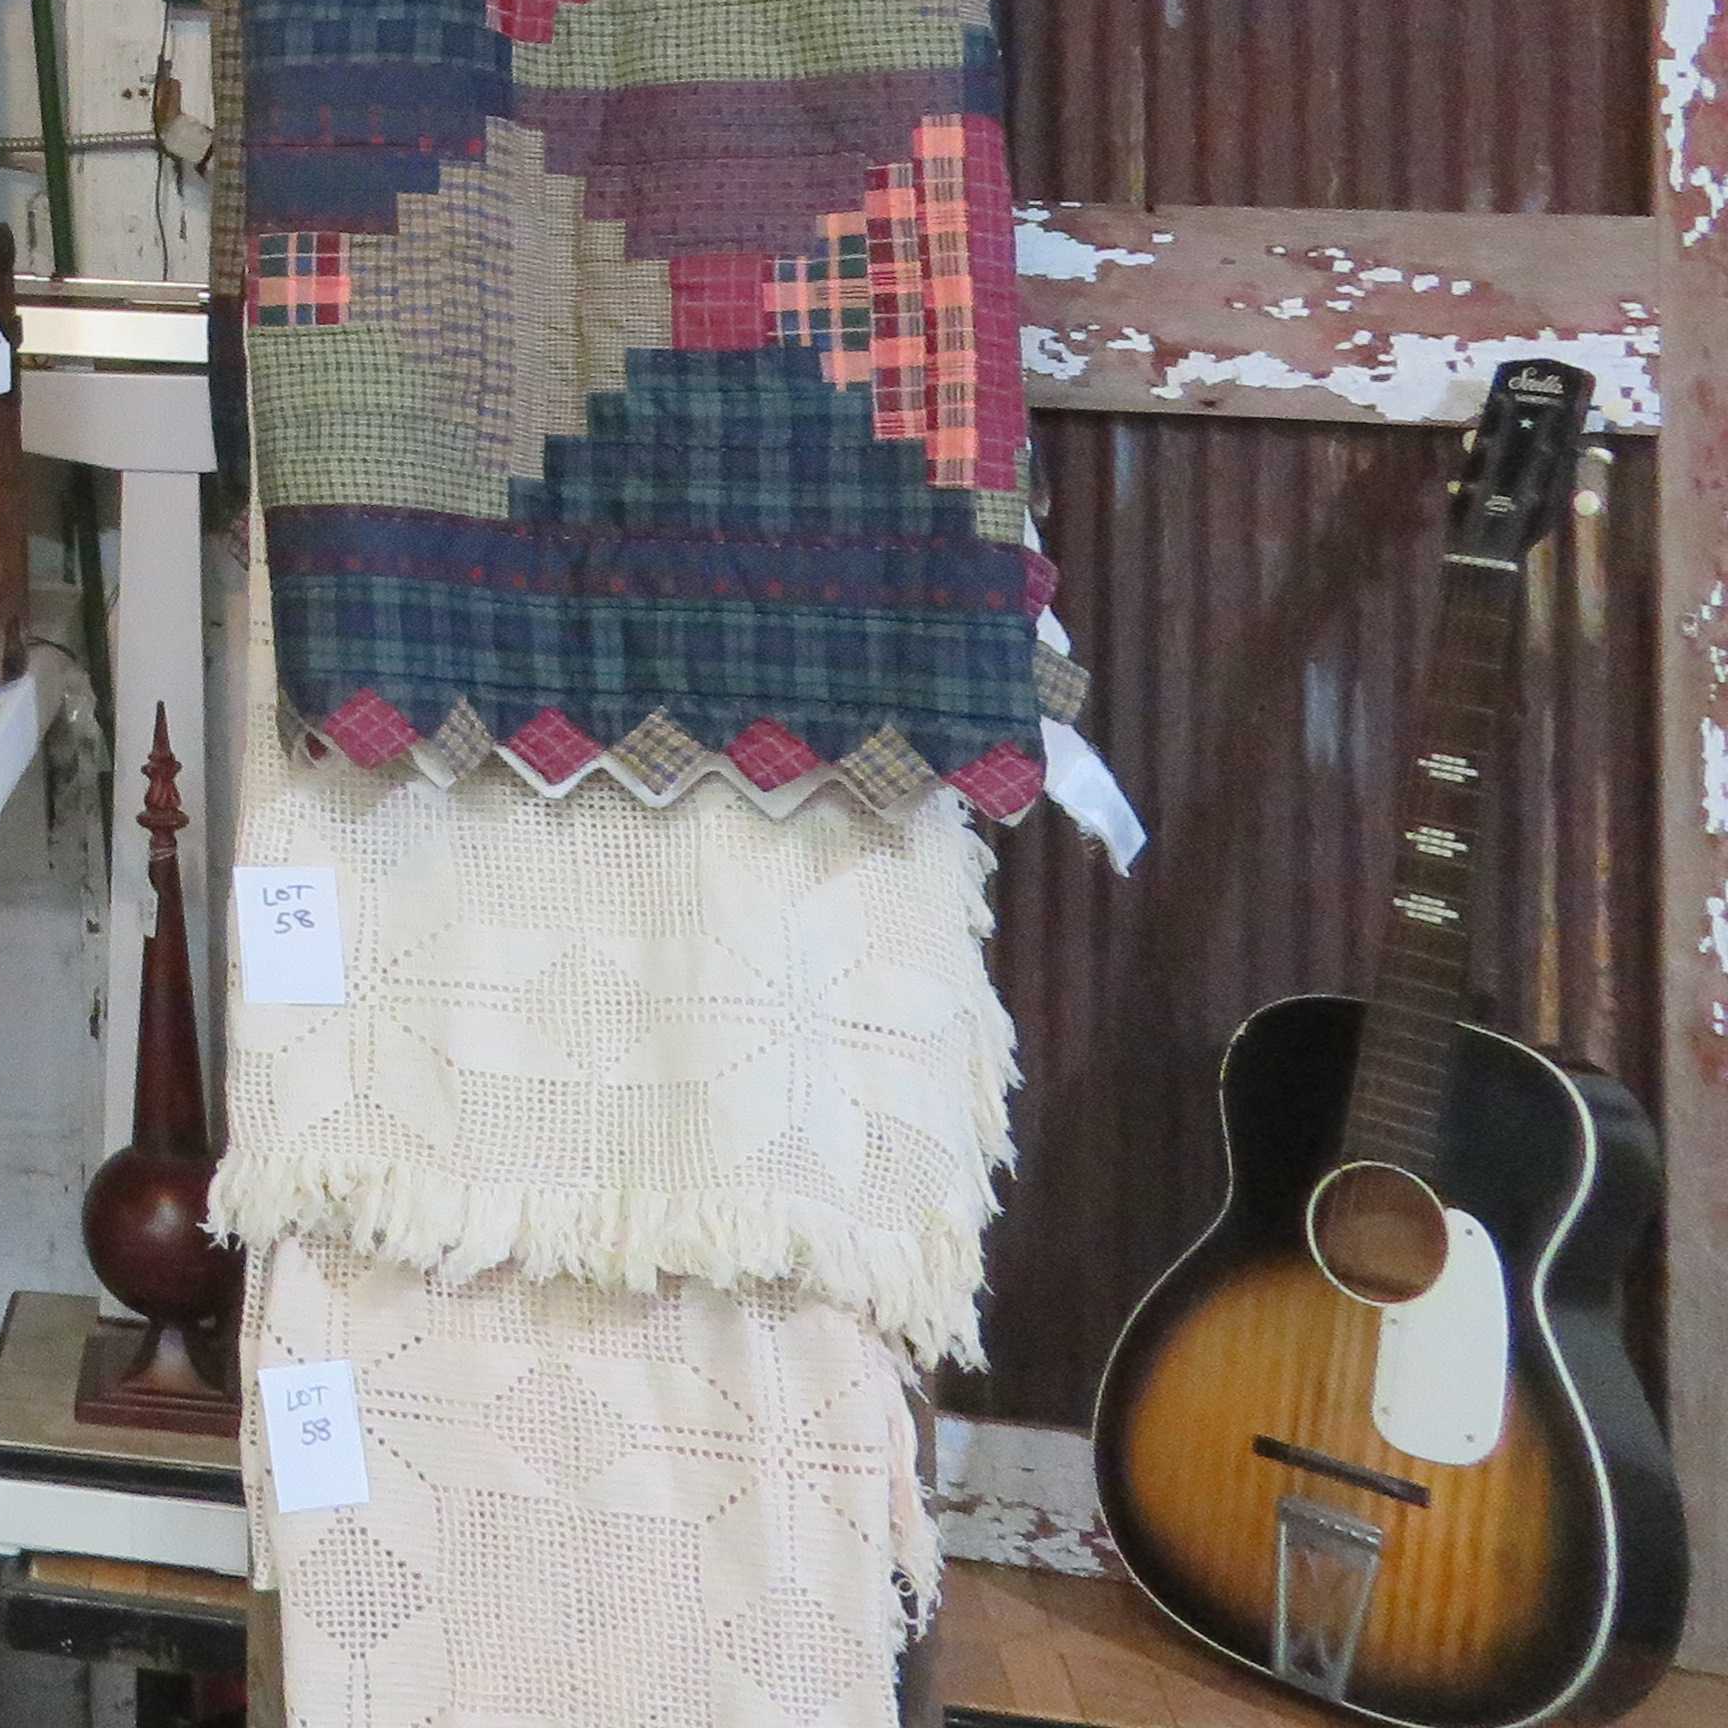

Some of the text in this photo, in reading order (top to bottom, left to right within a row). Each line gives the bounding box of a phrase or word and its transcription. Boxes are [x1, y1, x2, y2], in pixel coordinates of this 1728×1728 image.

[263, 884, 317, 906] LOT
[273, 909, 315, 934] 58
[286, 1385, 329, 1412] LOT
[301, 1417, 332, 1446] 58
